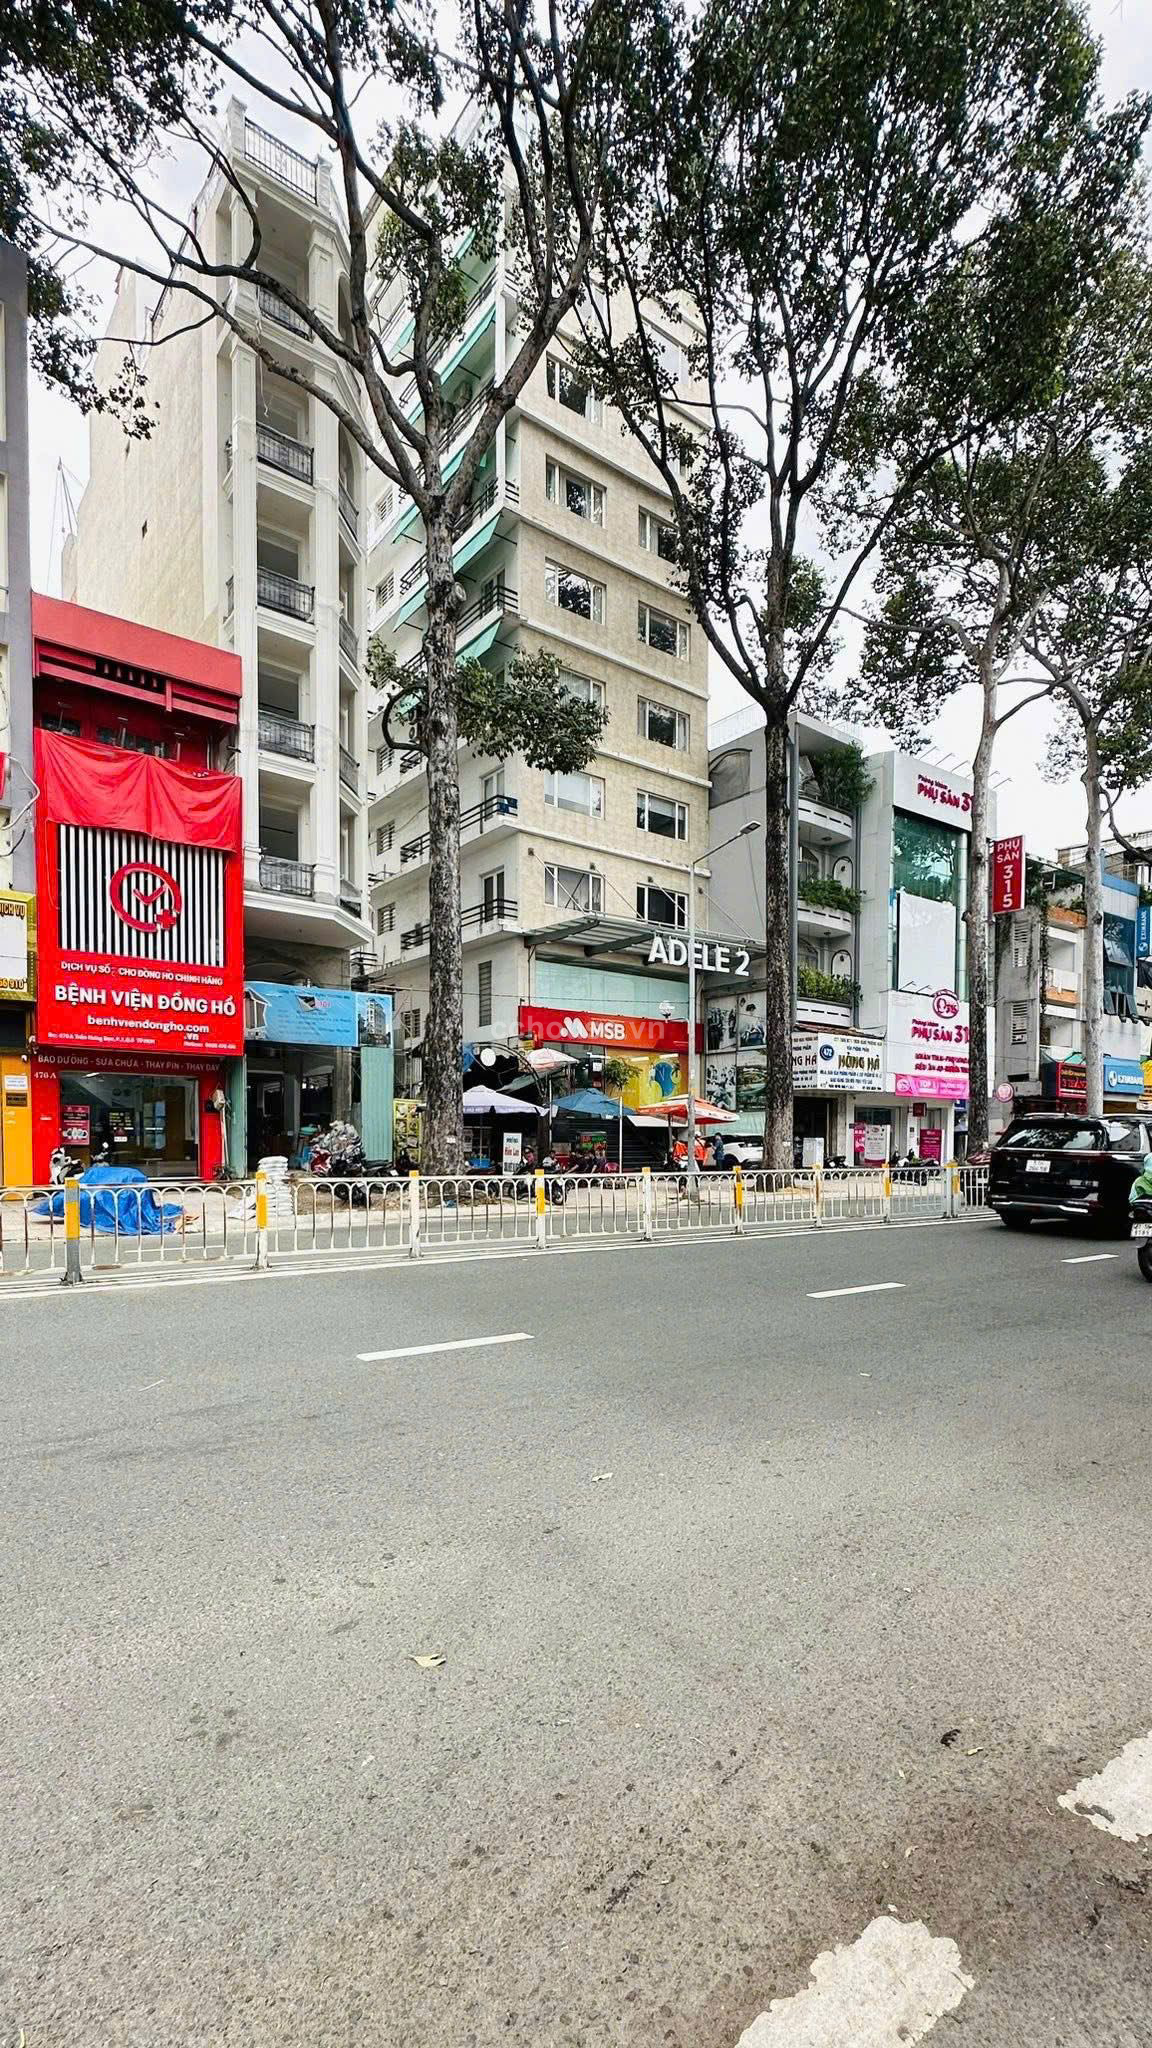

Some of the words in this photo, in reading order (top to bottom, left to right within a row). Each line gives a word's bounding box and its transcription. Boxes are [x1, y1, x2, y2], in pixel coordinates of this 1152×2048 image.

[917, 783, 938, 804] PHỤ
[940, 789, 960, 808] SẢN
[997, 840, 1020, 853] PHỤ
[997, 851, 1020, 864] SẢN
[15, 904, 25, 920] VỤ
[648, 935, 730, 973] ADELE
[734, 951, 750, 976] 2
[61, 961, 83, 972] DỊCH
[84, 963, 97, 975] VỤ
[98, 963, 111, 974] SỐ
[118, 967, 137, 977] CHO
[55, 982, 107, 1006] BỆNH
[111, 987, 154, 1012] VIỆN
[157, 990, 208, 1014] ĐỒNG
[211, 994, 236, 1016] HỒ
[87, 1015, 209, 1033] benhviendongho.com
[590, 1021, 625, 1040] MSB
[183, 1031, 199, 1041] .vn
[912, 1027, 932, 1042] PHỤ
[933, 1026, 953, 1042] SẢN
[954, 1025, 970, 1044] 31
[145, 1060, 165, 1070] THAY
[186, 1063, 204, 1071] THAY
